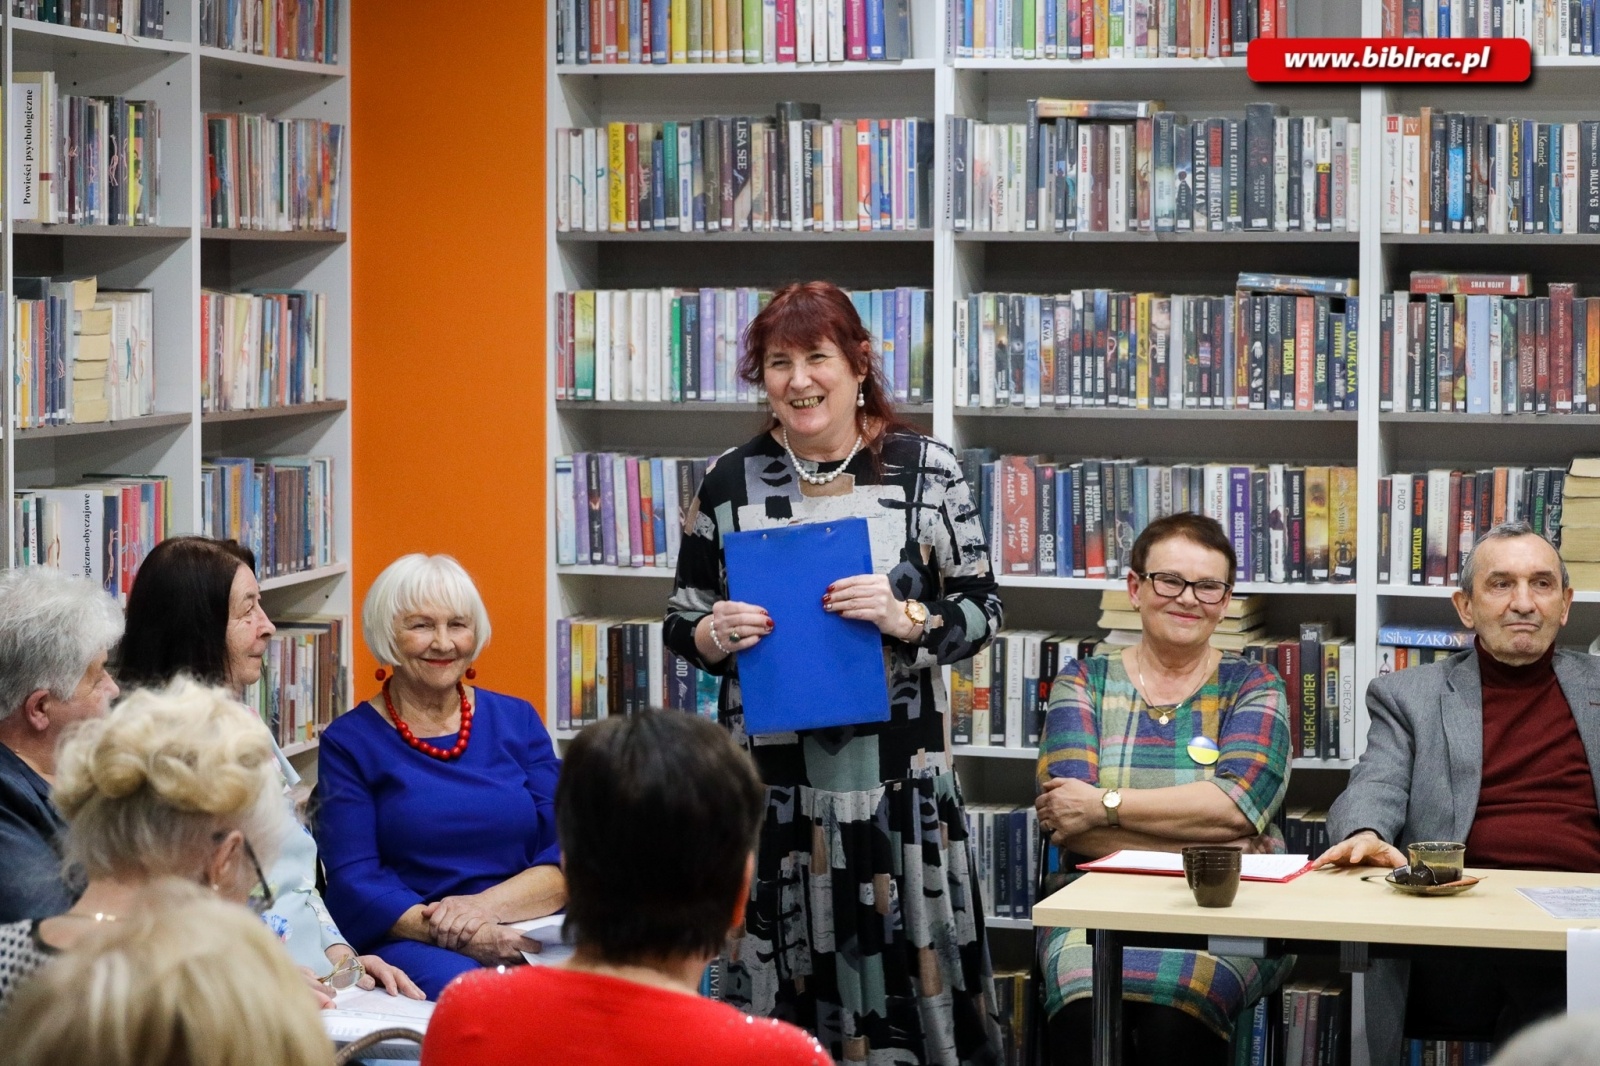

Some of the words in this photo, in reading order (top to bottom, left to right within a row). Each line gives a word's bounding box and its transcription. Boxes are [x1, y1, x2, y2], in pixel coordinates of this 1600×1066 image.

[1408, 8, 1421, 30] FOX
[1493, 7, 1502, 28] ŚCIGANA
[1561, 17, 1569, 39] ZBRODNI
[23, 89, 34, 161] psychologiczne
[737, 121, 747, 147] LISA
[1386, 121, 1398, 130] III
[1405, 124, 1418, 133] IV
[804, 129, 812, 150] Carol
[1538, 136, 1547, 167] Kernick
[737, 149, 747, 170] SEE
[804, 152, 812, 179] Shields
[1336, 155, 1344, 186] ESCAPE
[1196, 139, 1205, 205] OPIEKUNKA
[1211, 173, 1219, 193] JANE
[1590, 169, 1599, 195] DALLAS
[22, 164, 32, 205] Powieści
[1211, 197, 1219, 222] CASEY
[1336, 189, 1344, 216] ROOM
[1590, 196, 1598, 207] '63
[1487, 281, 1505, 289] WOJNY
[1042, 319, 1050, 342] KAVA
[1057, 318, 1066, 342] KAVA
[1269, 303, 1277, 335] MUSSO
[1299, 327, 1309, 336] ŻE
[1299, 337, 1308, 348] CIĘ
[1157, 332, 1165, 363] KELLERMAN
[1283, 338, 1293, 375] TOPIELISKA
[1299, 349, 1308, 361] NIE
[1057, 348, 1067, 394] KOLEKCJONER
[1316, 353, 1326, 383] SŁUŻĄCA
[1347, 330, 1356, 393] UWIKŁANA
[1299, 362, 1309, 393] OPUSZCZĘ
[1008, 466, 1018, 505] ŻULCZYK
[1018, 473, 1028, 496] JAKUB
[1105, 467, 1113, 488] JEFFREY
[1119, 467, 1128, 489] JEFFREY
[1414, 479, 1424, 499] Mario
[1536, 473, 1545, 497] TOMASZ
[1042, 484, 1050, 507] Rachel
[1085, 485, 1093, 505] PRZEZ
[1093, 485, 1101, 521] WĘDRÓWKA
[1105, 489, 1114, 511] ARCHER
[1120, 490, 1130, 512] ARCHER
[1153, 481, 1161, 511] ARCHER
[1398, 489, 1406, 511] PUZO
[1552, 480, 1560, 504] TOMASZ
[1085, 507, 1094, 532] SŁOŃCE
[1414, 499, 1424, 516] Puzo
[1042, 508, 1050, 532] Abbott
[1234, 512, 1244, 538] SZÓSTE
[1463, 510, 1473, 538] OSTATNI
[1008, 523, 1018, 549] PSÓW
[1019, 517, 1029, 554] WZGÓRZE
[1045, 533, 1054, 562] OBCE
[1234, 538, 1244, 567] DZIECKO
[1412, 527, 1423, 570] SYCYLIJCZYK
[1385, 631, 1412, 643] Silva
[1416, 634, 1462, 647] ZAKON
[1327, 670, 1336, 706] CLANCY
[1343, 675, 1351, 724] UCIECZKA
[1253, 1035, 1261, 1054] MŁOT
